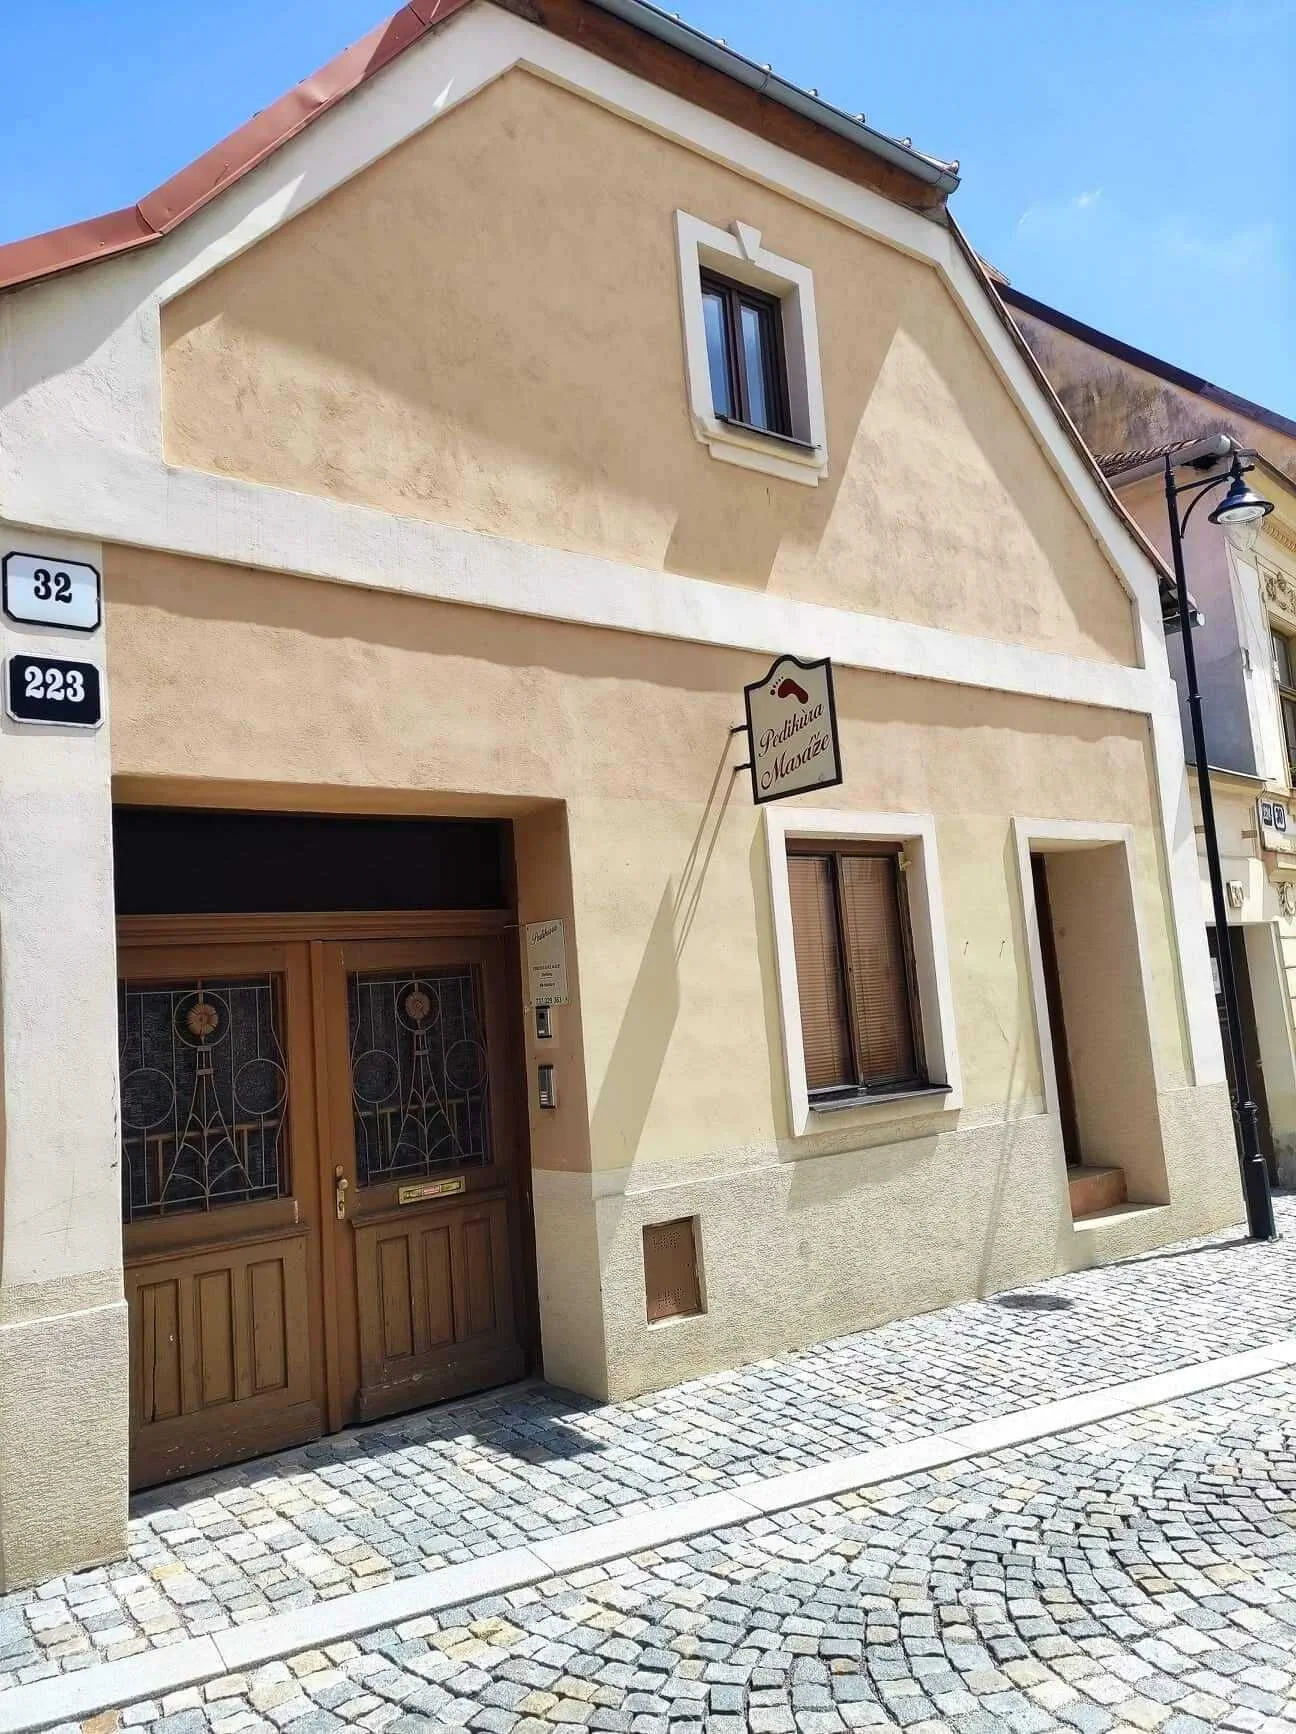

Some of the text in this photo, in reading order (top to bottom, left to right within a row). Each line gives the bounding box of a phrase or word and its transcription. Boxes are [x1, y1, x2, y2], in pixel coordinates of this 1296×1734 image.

[34, 568, 73, 604] 32
[24, 665, 86, 703] 223
[761, 731, 830, 790] Masáže
